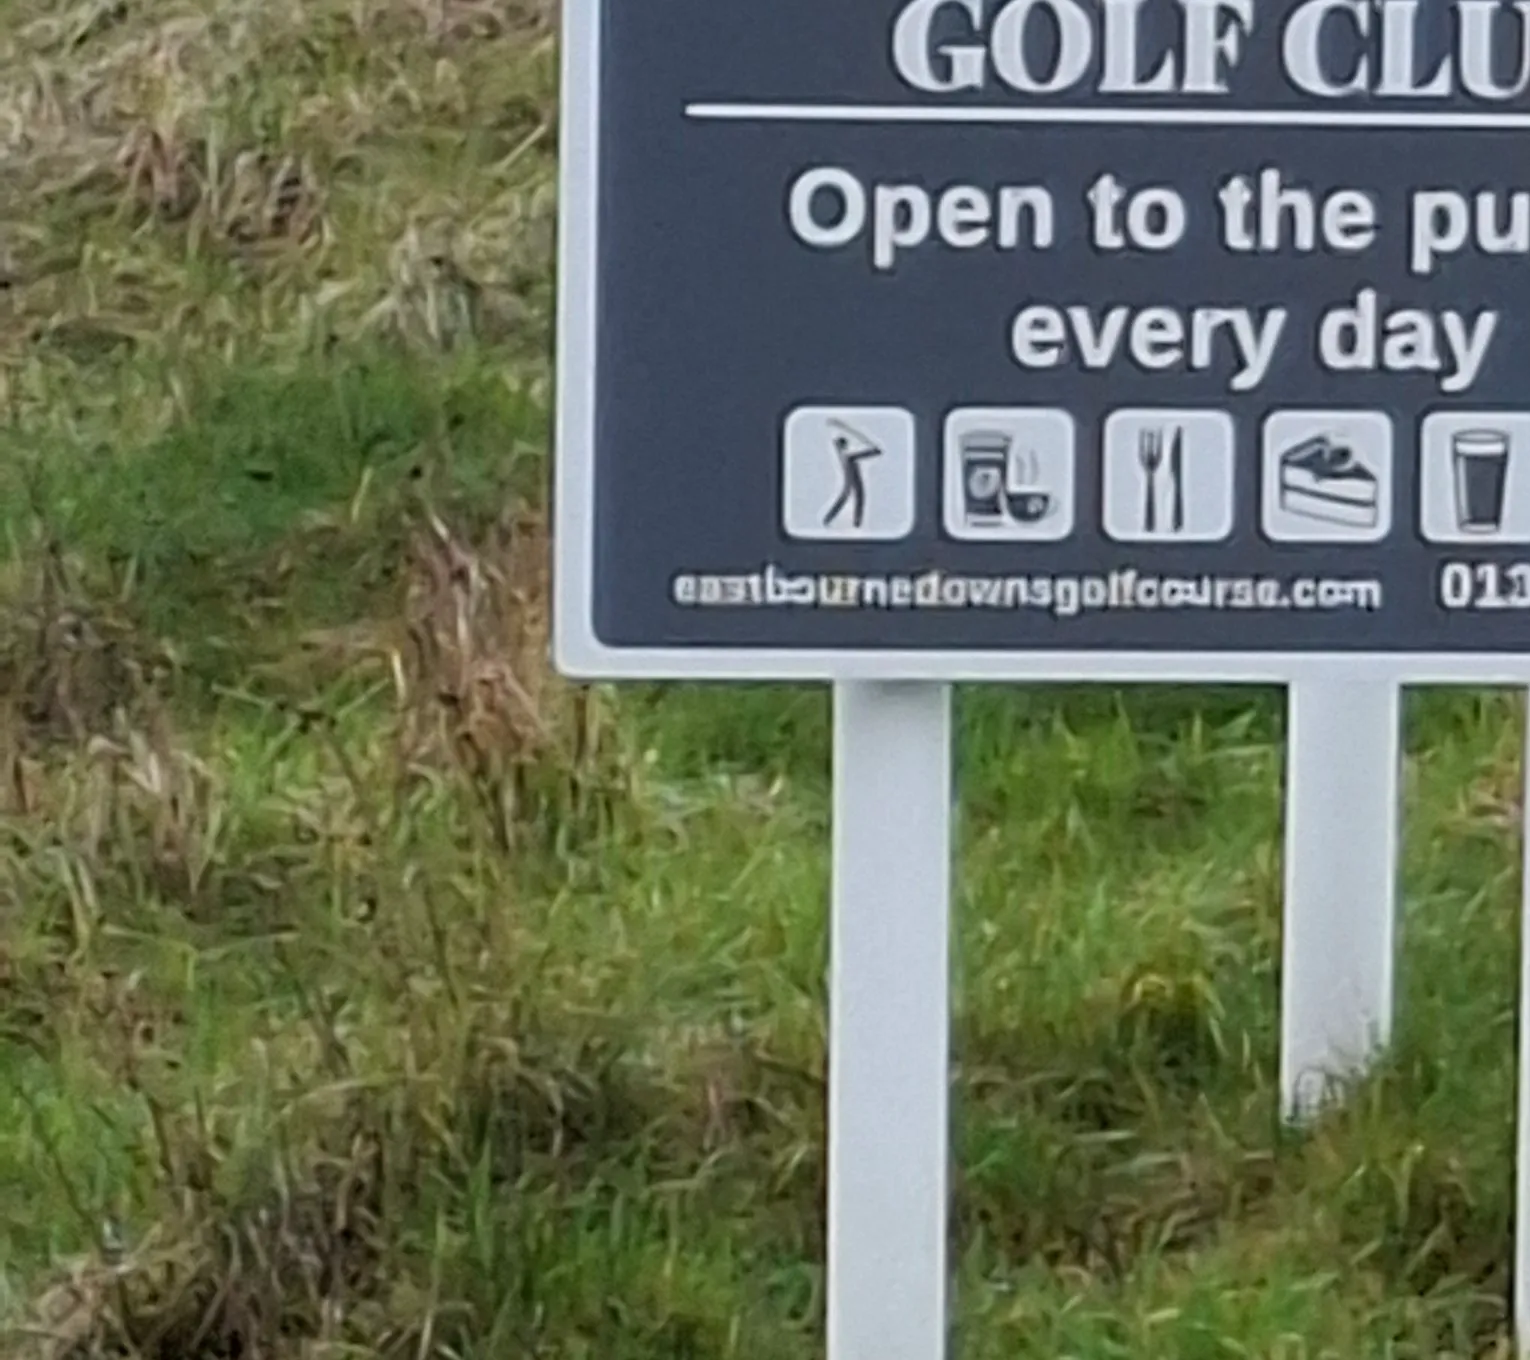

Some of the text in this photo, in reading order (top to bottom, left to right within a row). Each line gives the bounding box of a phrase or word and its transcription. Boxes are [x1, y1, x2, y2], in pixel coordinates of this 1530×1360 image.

[788, 167, 1055, 269] Open
[1087, 173, 1187, 250] to
[1217, 168, 1377, 252] the
[1011, 290, 1499, 392] every day
